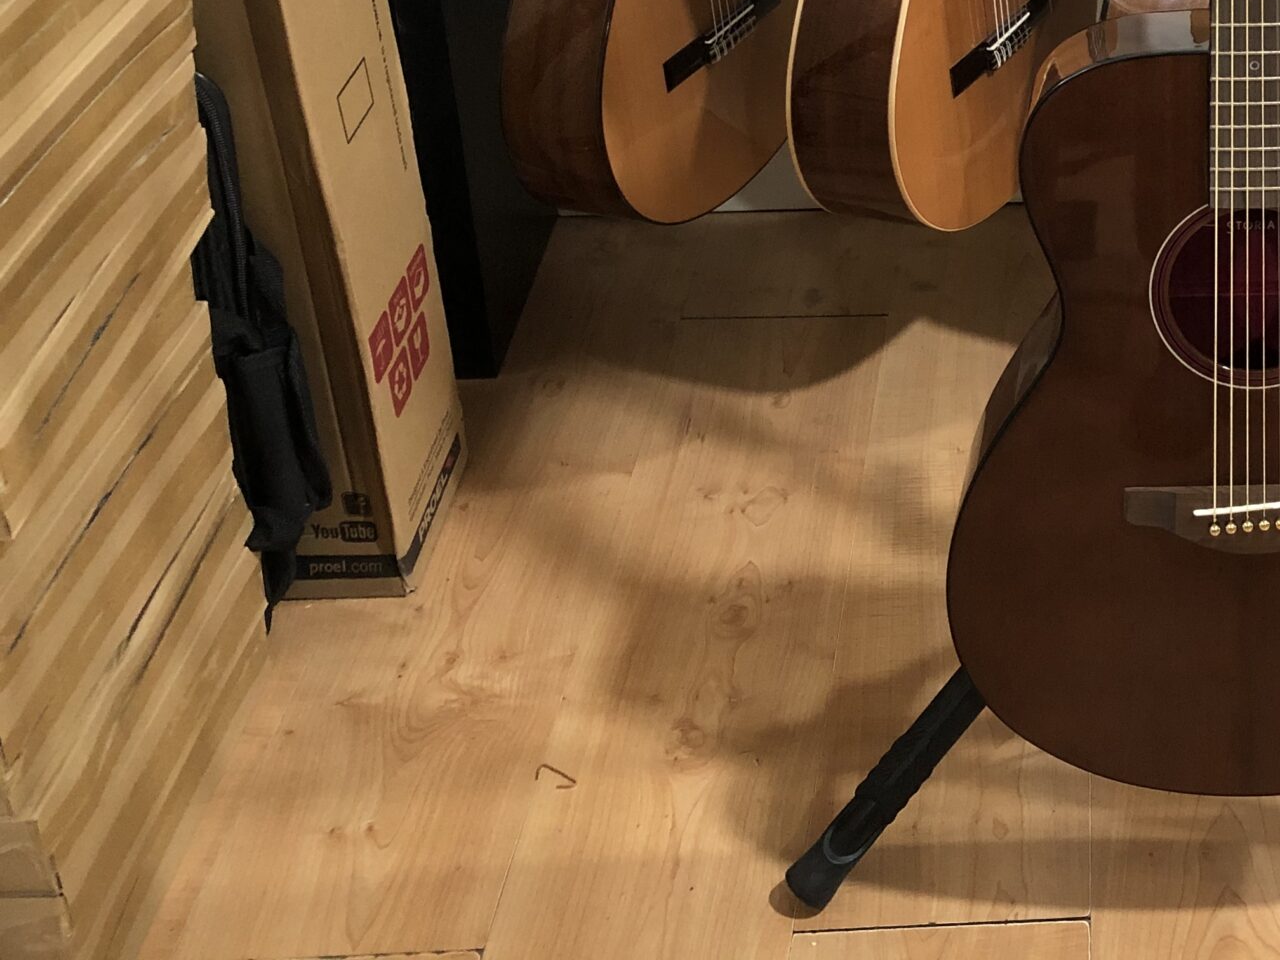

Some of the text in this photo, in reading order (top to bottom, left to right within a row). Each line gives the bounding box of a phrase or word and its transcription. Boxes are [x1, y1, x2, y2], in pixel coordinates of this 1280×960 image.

[418, 473, 449, 543] PROEL
[311, 523, 377, 541] YouTube
[309, 560, 382, 576] proel.com
